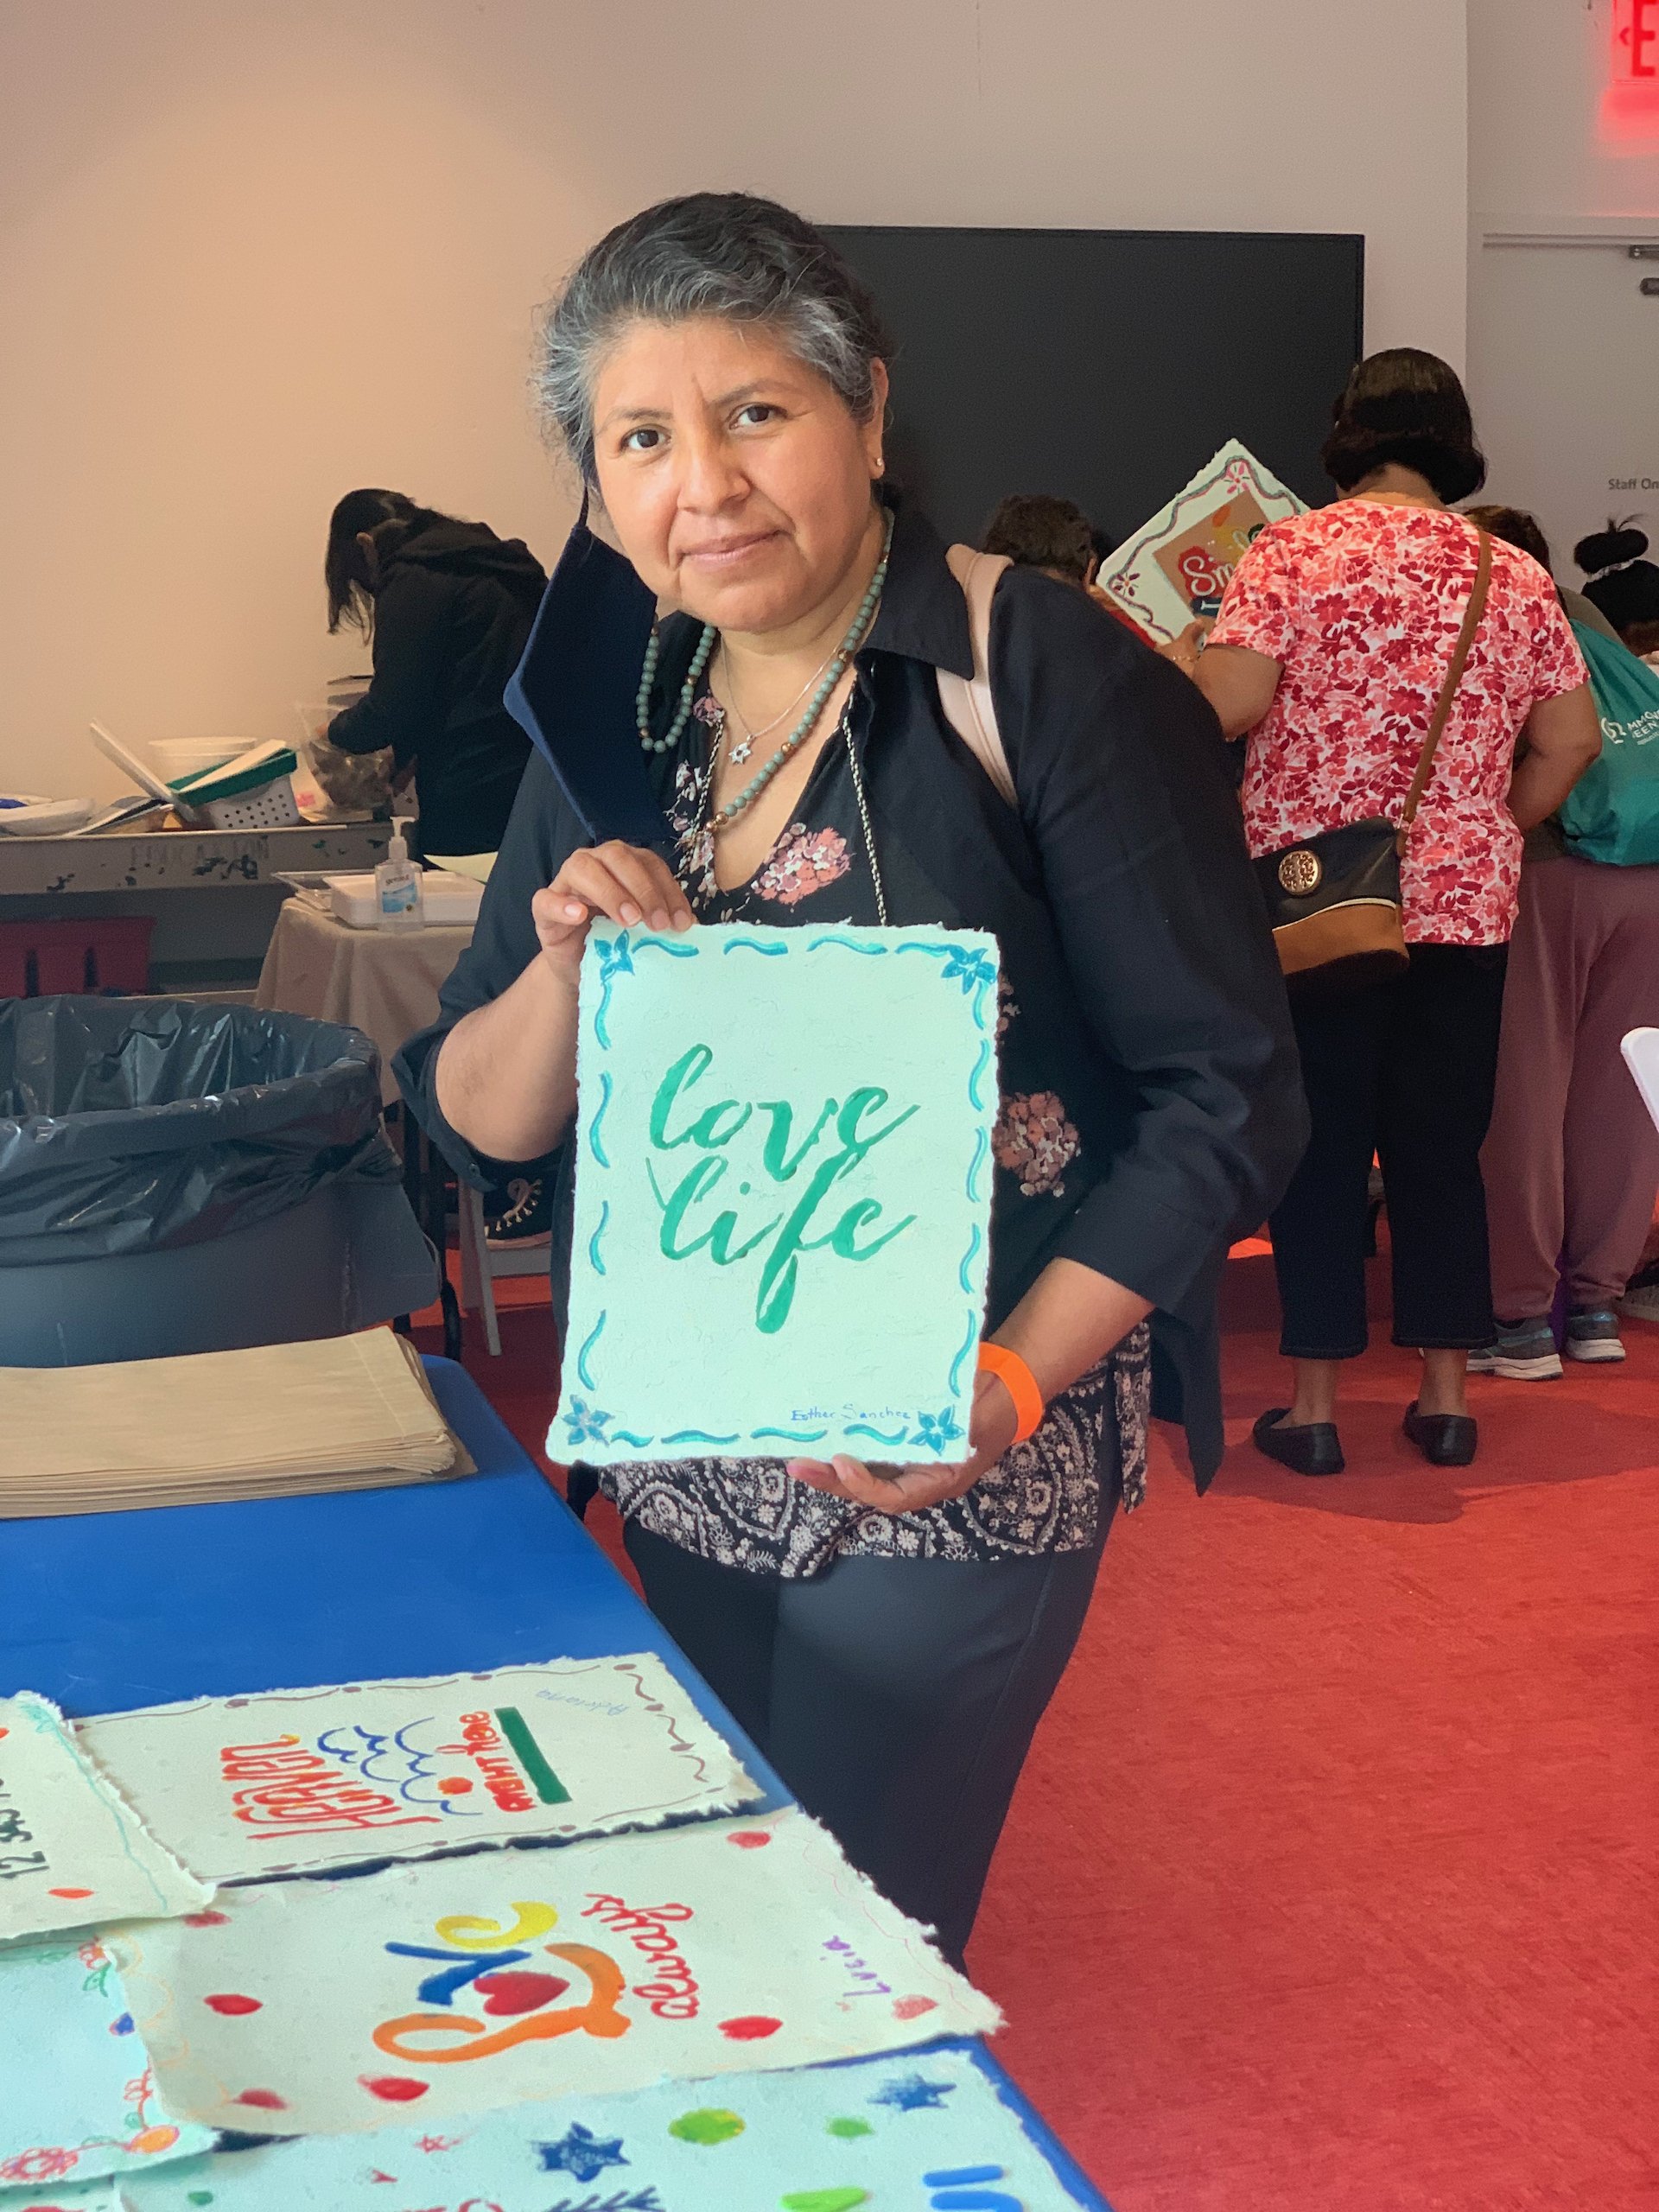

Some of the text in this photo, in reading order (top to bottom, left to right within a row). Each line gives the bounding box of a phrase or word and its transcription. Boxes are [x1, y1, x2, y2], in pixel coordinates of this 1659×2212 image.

[1608, 478, 1637, 490] Staff
[649, 1043, 921, 1182] love
[645, 1154, 918, 1334] life
[790, 1406, 836, 1421] Esther
[580, 1893, 700, 2019] always
